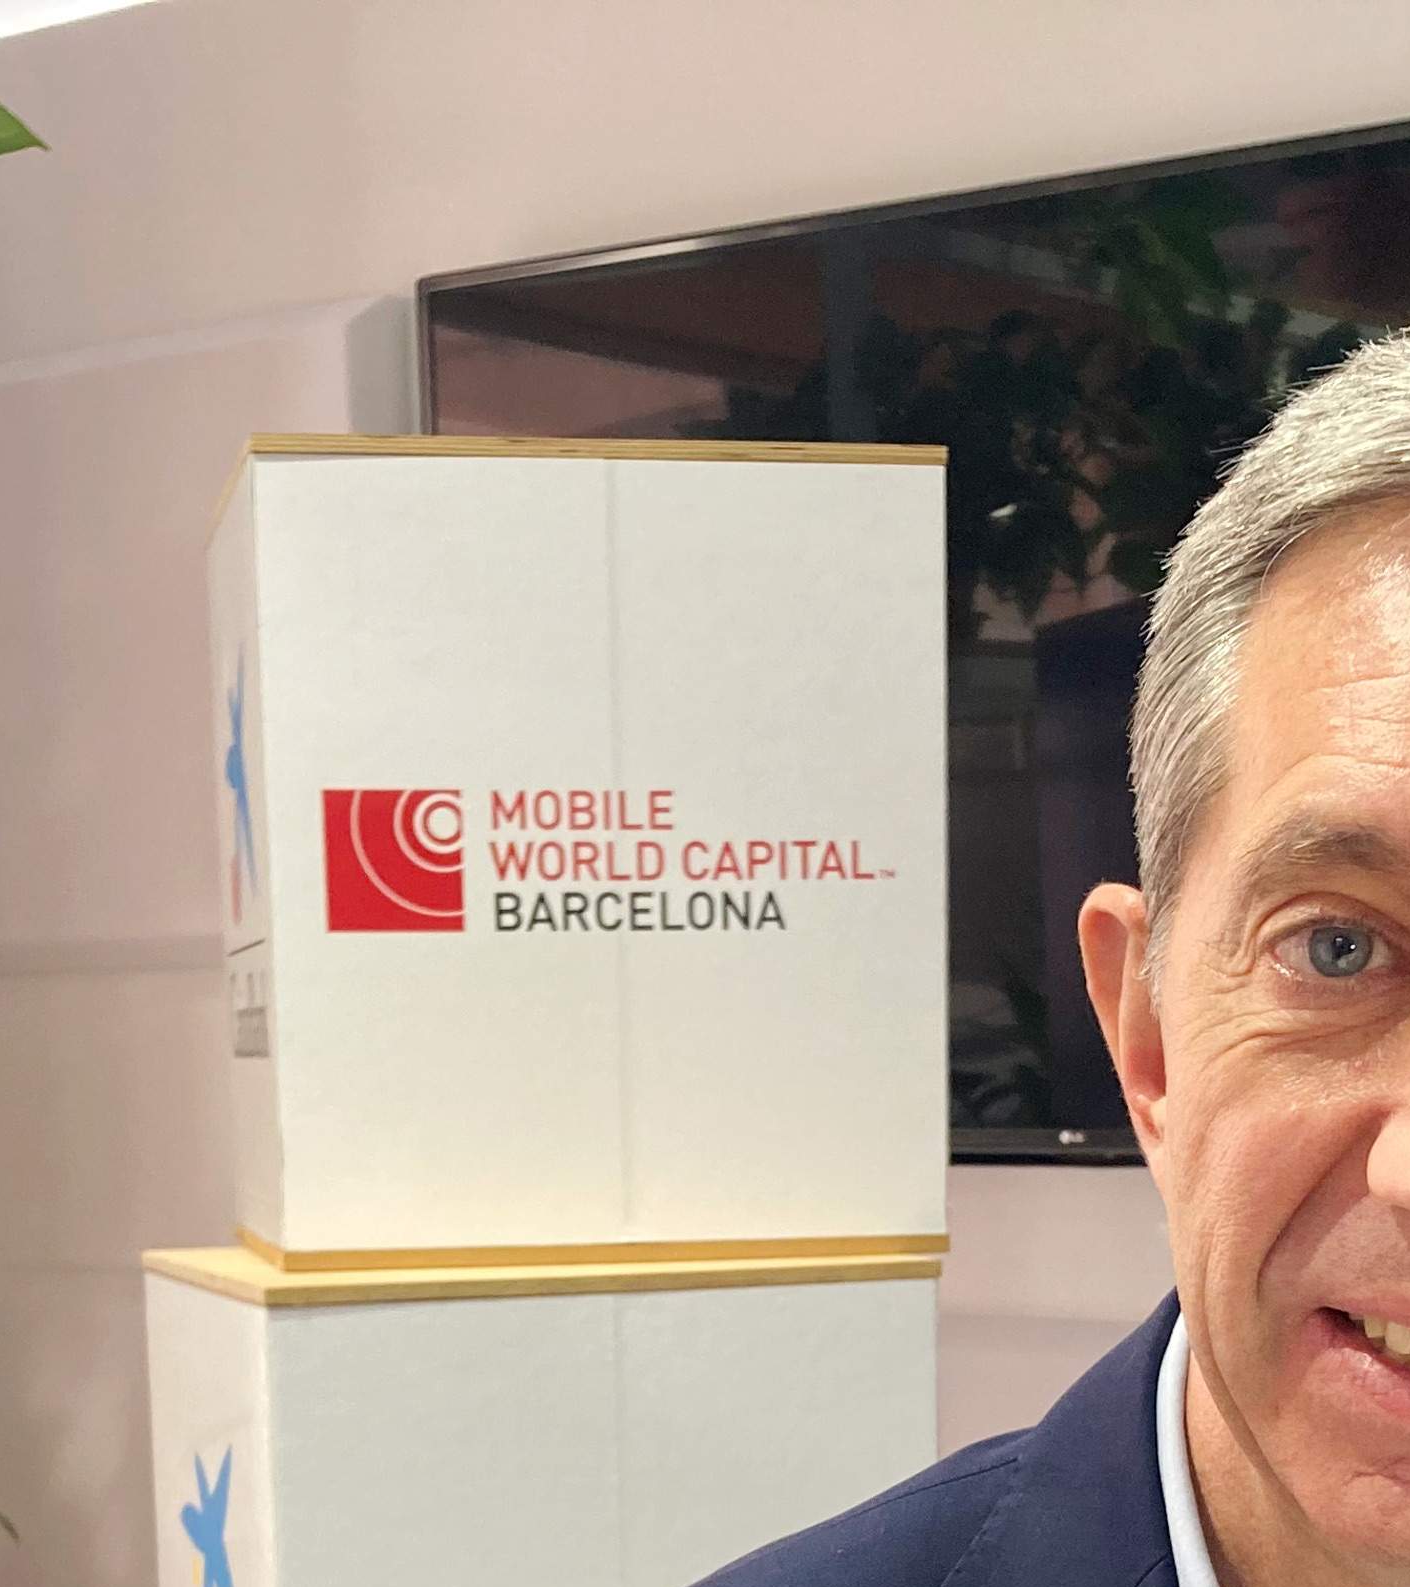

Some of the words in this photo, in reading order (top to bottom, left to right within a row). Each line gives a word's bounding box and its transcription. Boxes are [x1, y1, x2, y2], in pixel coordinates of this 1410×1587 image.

[490, 790, 674, 831] MOBILE
[489, 840, 665, 881] WORLD
[493, 891, 787, 932] BARCELONA
